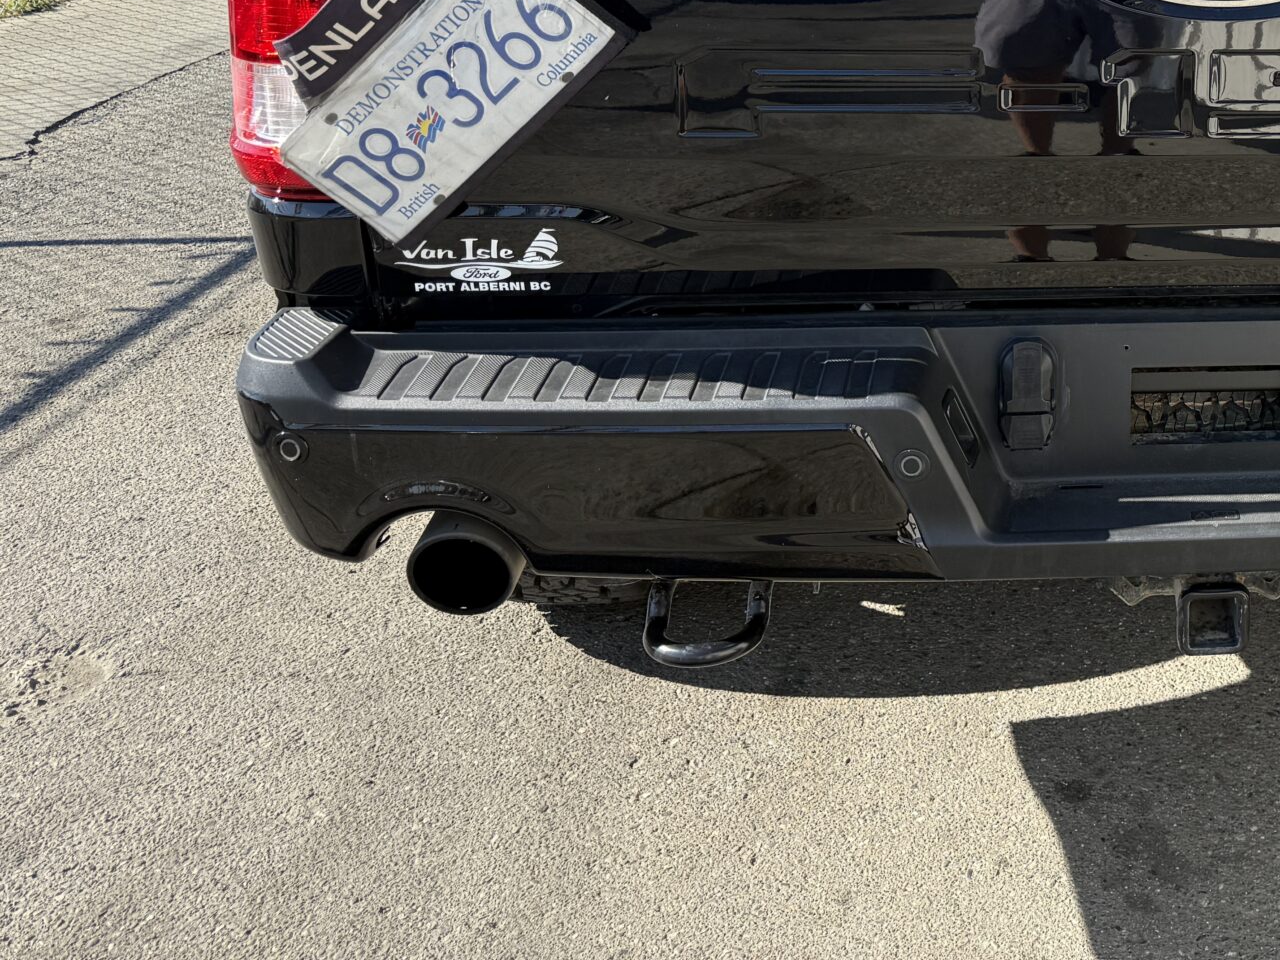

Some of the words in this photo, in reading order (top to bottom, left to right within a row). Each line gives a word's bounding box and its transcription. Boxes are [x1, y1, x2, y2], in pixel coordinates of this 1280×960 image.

[397, 181, 441, 221] British
[536, 31, 598, 88] Columbia
[321, 127, 426, 217] D8
[402, 240, 457, 260] Van
[460, 238, 515, 261] Isle
[462, 267, 500, 280] Ford
[414, 282, 455, 292] PORT
[460, 281, 526, 292] ALBERNI
[530, 281, 551, 291] BC
